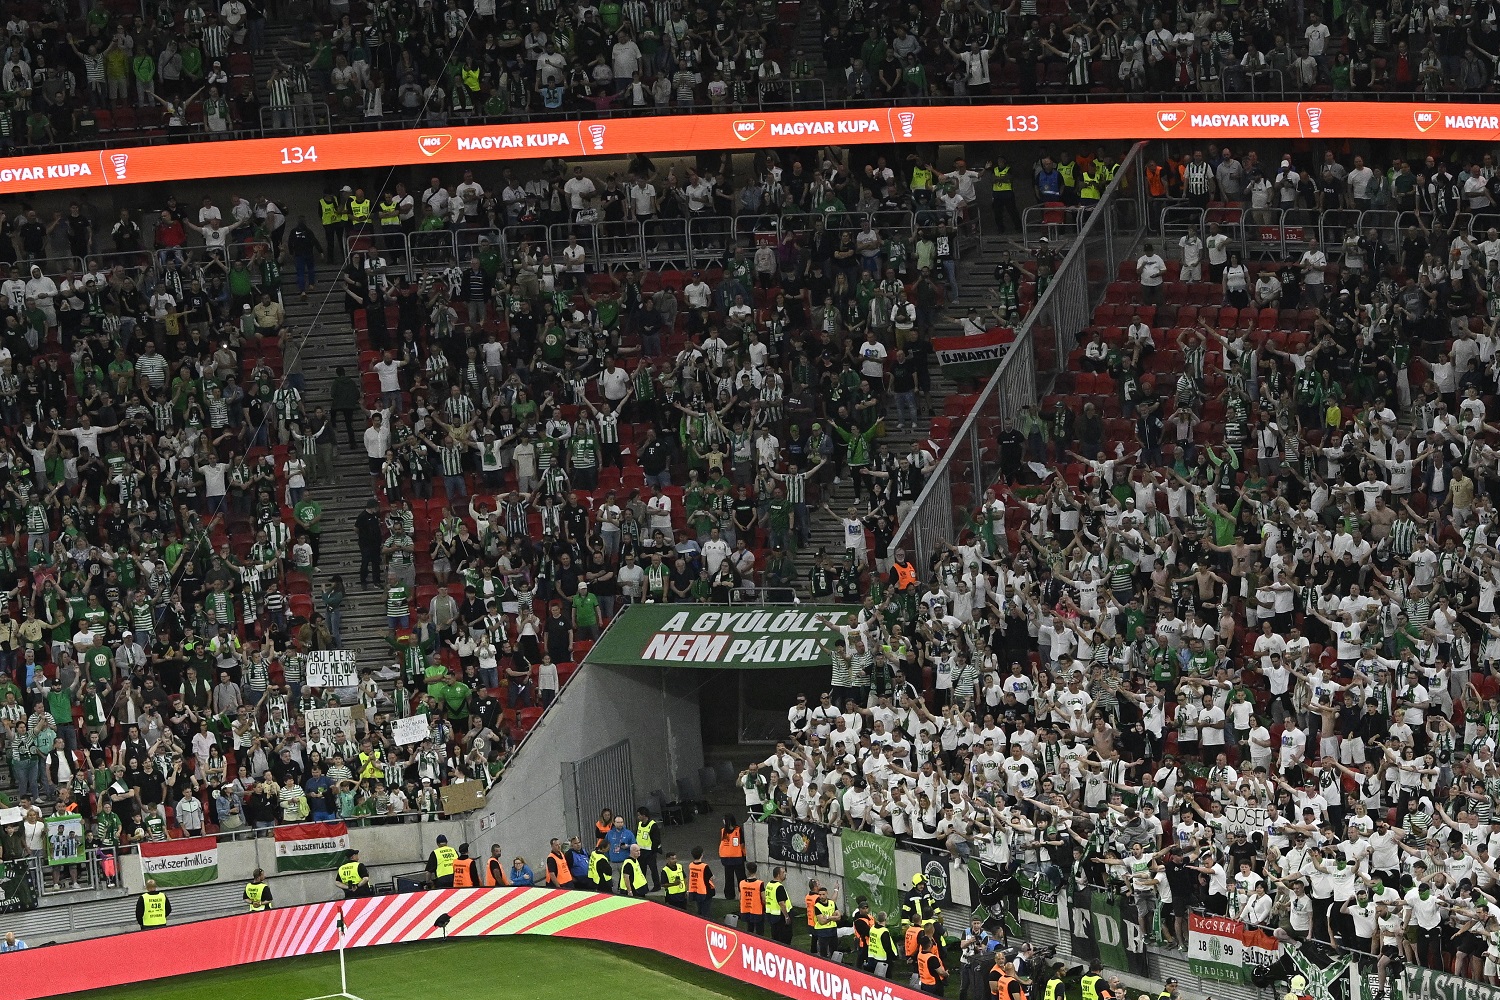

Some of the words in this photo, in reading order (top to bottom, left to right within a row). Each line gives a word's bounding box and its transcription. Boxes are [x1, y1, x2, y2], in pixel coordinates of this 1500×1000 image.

[770, 121, 835, 136] MAGYAR
[837, 119, 880, 134] KUPA
[1005, 115, 1039, 132] 133
[1190, 114, 1249, 128] MAGYAR
[1251, 114, 1290, 127] KUPA
[1444, 115, 1498, 129] MAGYAR
[456, 134, 524, 151] MAGYAR
[526, 132, 570, 147] KUPA
[280, 145, 318, 165] 134
[0, 166, 45, 183] GYAR
[46, 162, 92, 179] KUPA
[661, 612, 689, 632] A
[642, 633, 730, 663] NEM
[724, 635, 829, 663] PÁLYA!
[308, 651, 324, 663] ABU
[309, 662, 329, 675] GIVE
[330, 662, 342, 675] ME
[321, 674, 351, 686] SHIRT
[1198, 940, 1207, 952] 18
[1223, 944, 1234, 956] 99
[709, 932, 728, 951] MOL
[741, 943, 807, 990] MAGYAR
